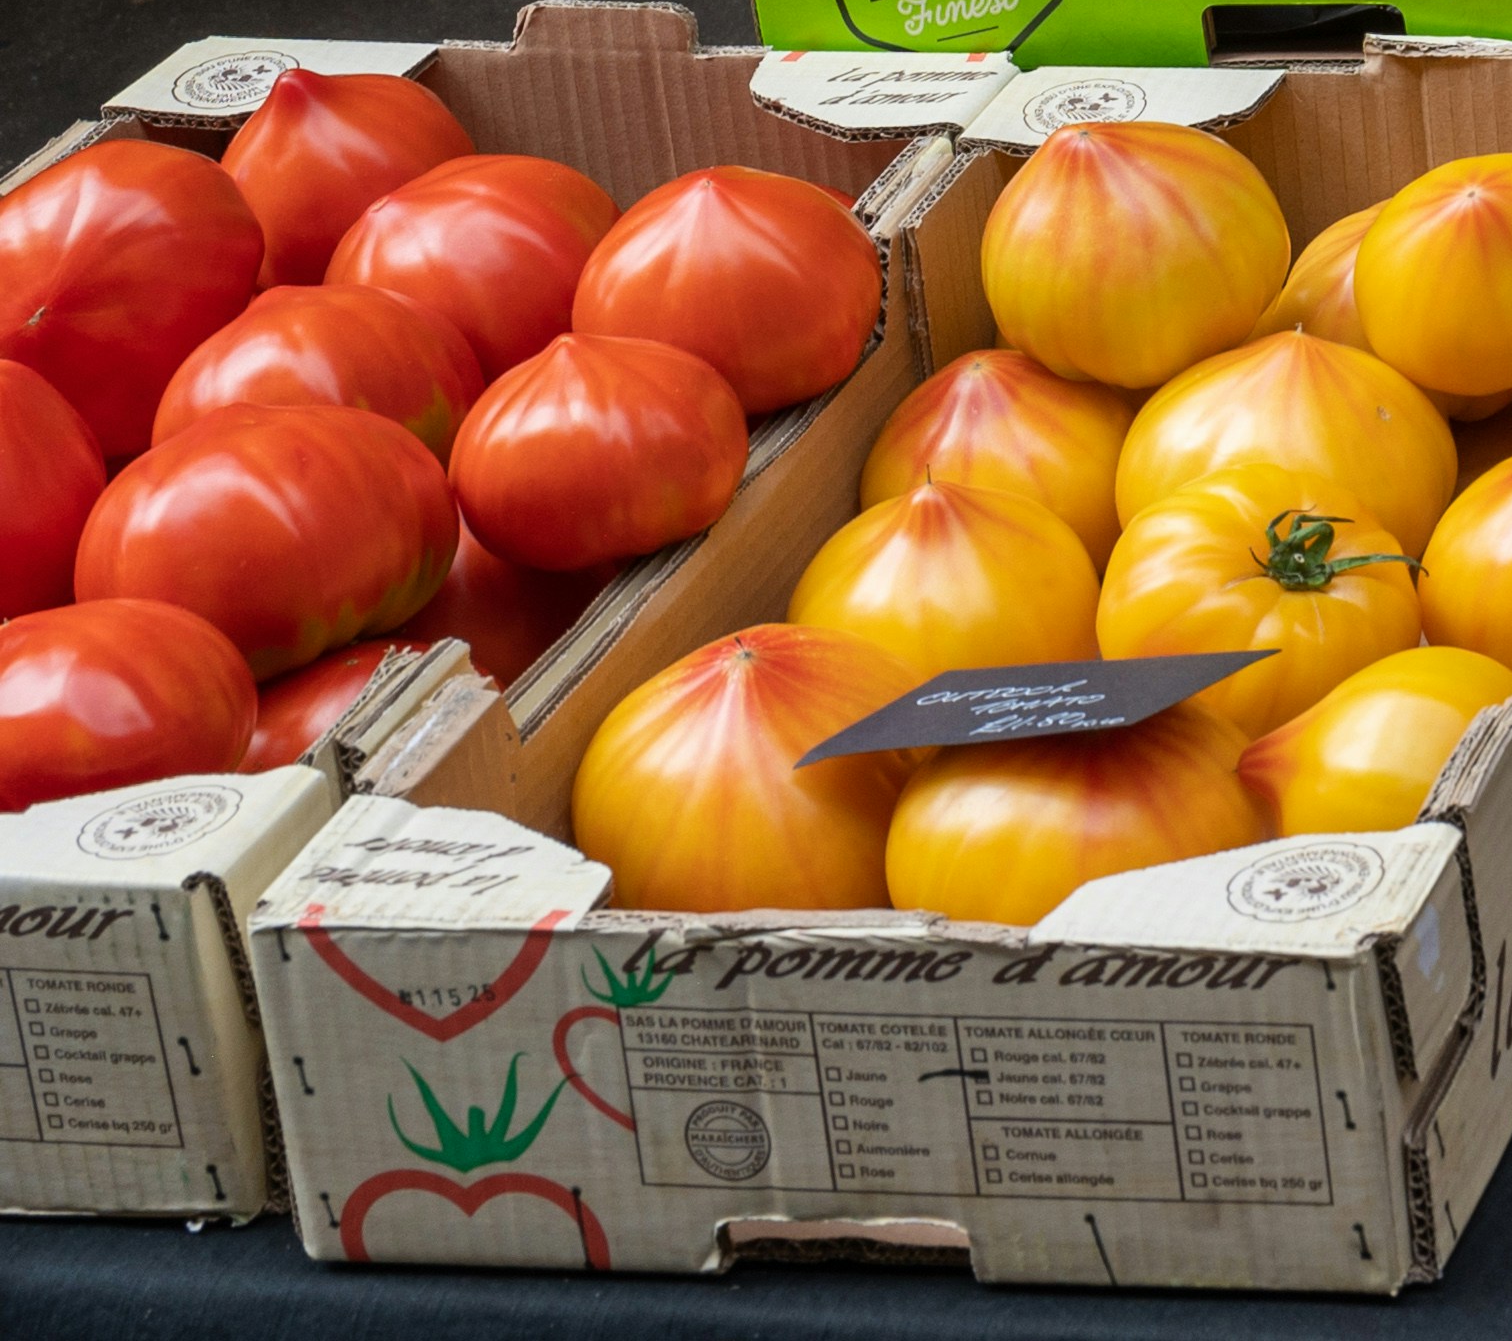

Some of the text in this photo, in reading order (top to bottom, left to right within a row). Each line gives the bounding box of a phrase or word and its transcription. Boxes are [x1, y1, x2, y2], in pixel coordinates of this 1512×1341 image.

[915, 679, 1089, 706] OUTDOOR
[970, 692, 1107, 714] TOMATO
[622, 931, 712, 977] la
[716, 946, 970, 990] pomme
[625, 1016, 655, 1031] SAS
[658, 1017, 675, 1031] LA
[680, 1019, 736, 1034] POMME
[819, 1023, 874, 1037] TOMATE
[637, 1032, 675, 1047] 13160
[965, 1027, 1021, 1041] TOMATE
[1026, 1027, 1106, 1042] ALLONGÉE
[1181, 1032, 1297, 1046] TOMATE RONDE
[643, 1058, 783, 1073] ORIGINE FRANCE
[644, 1074, 725, 1087] PROVENCE
[847, 1069, 887, 1083] Jaune
[1201, 1080, 1252, 1097] Grappe
[850, 1094, 893, 1109] Rouge
